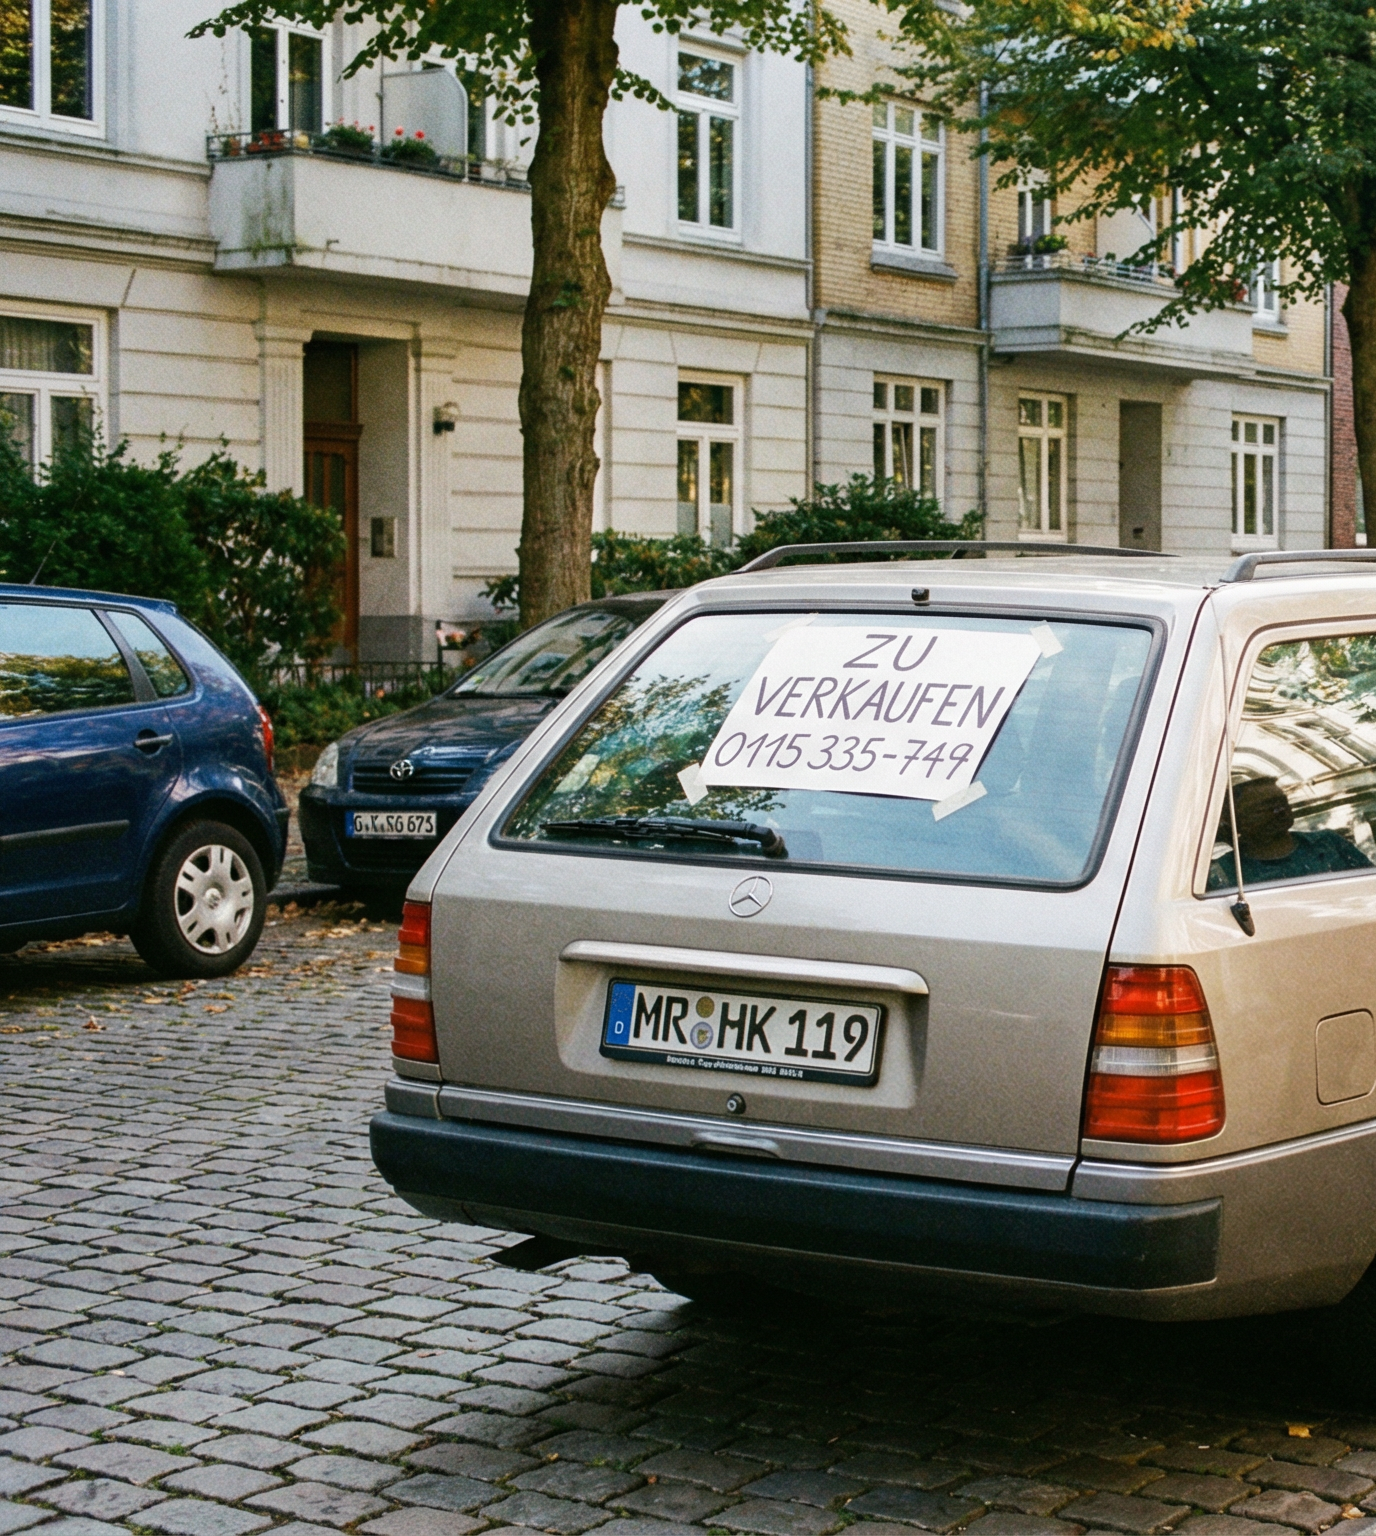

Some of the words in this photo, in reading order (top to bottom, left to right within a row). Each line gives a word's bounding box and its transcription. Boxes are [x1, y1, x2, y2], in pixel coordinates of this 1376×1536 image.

[843, 634, 938, 671] ZU
[754, 676, 1005, 729] VERKAUFEN
[714, 731, 811, 769] 0115
[807, 734, 974, 780] 335-749
[614, 1021, 625, 1035] D
[633, 992, 689, 1044] MR
[716, 1001, 777, 1054] HK
[784, 1009, 869, 1063] 119
